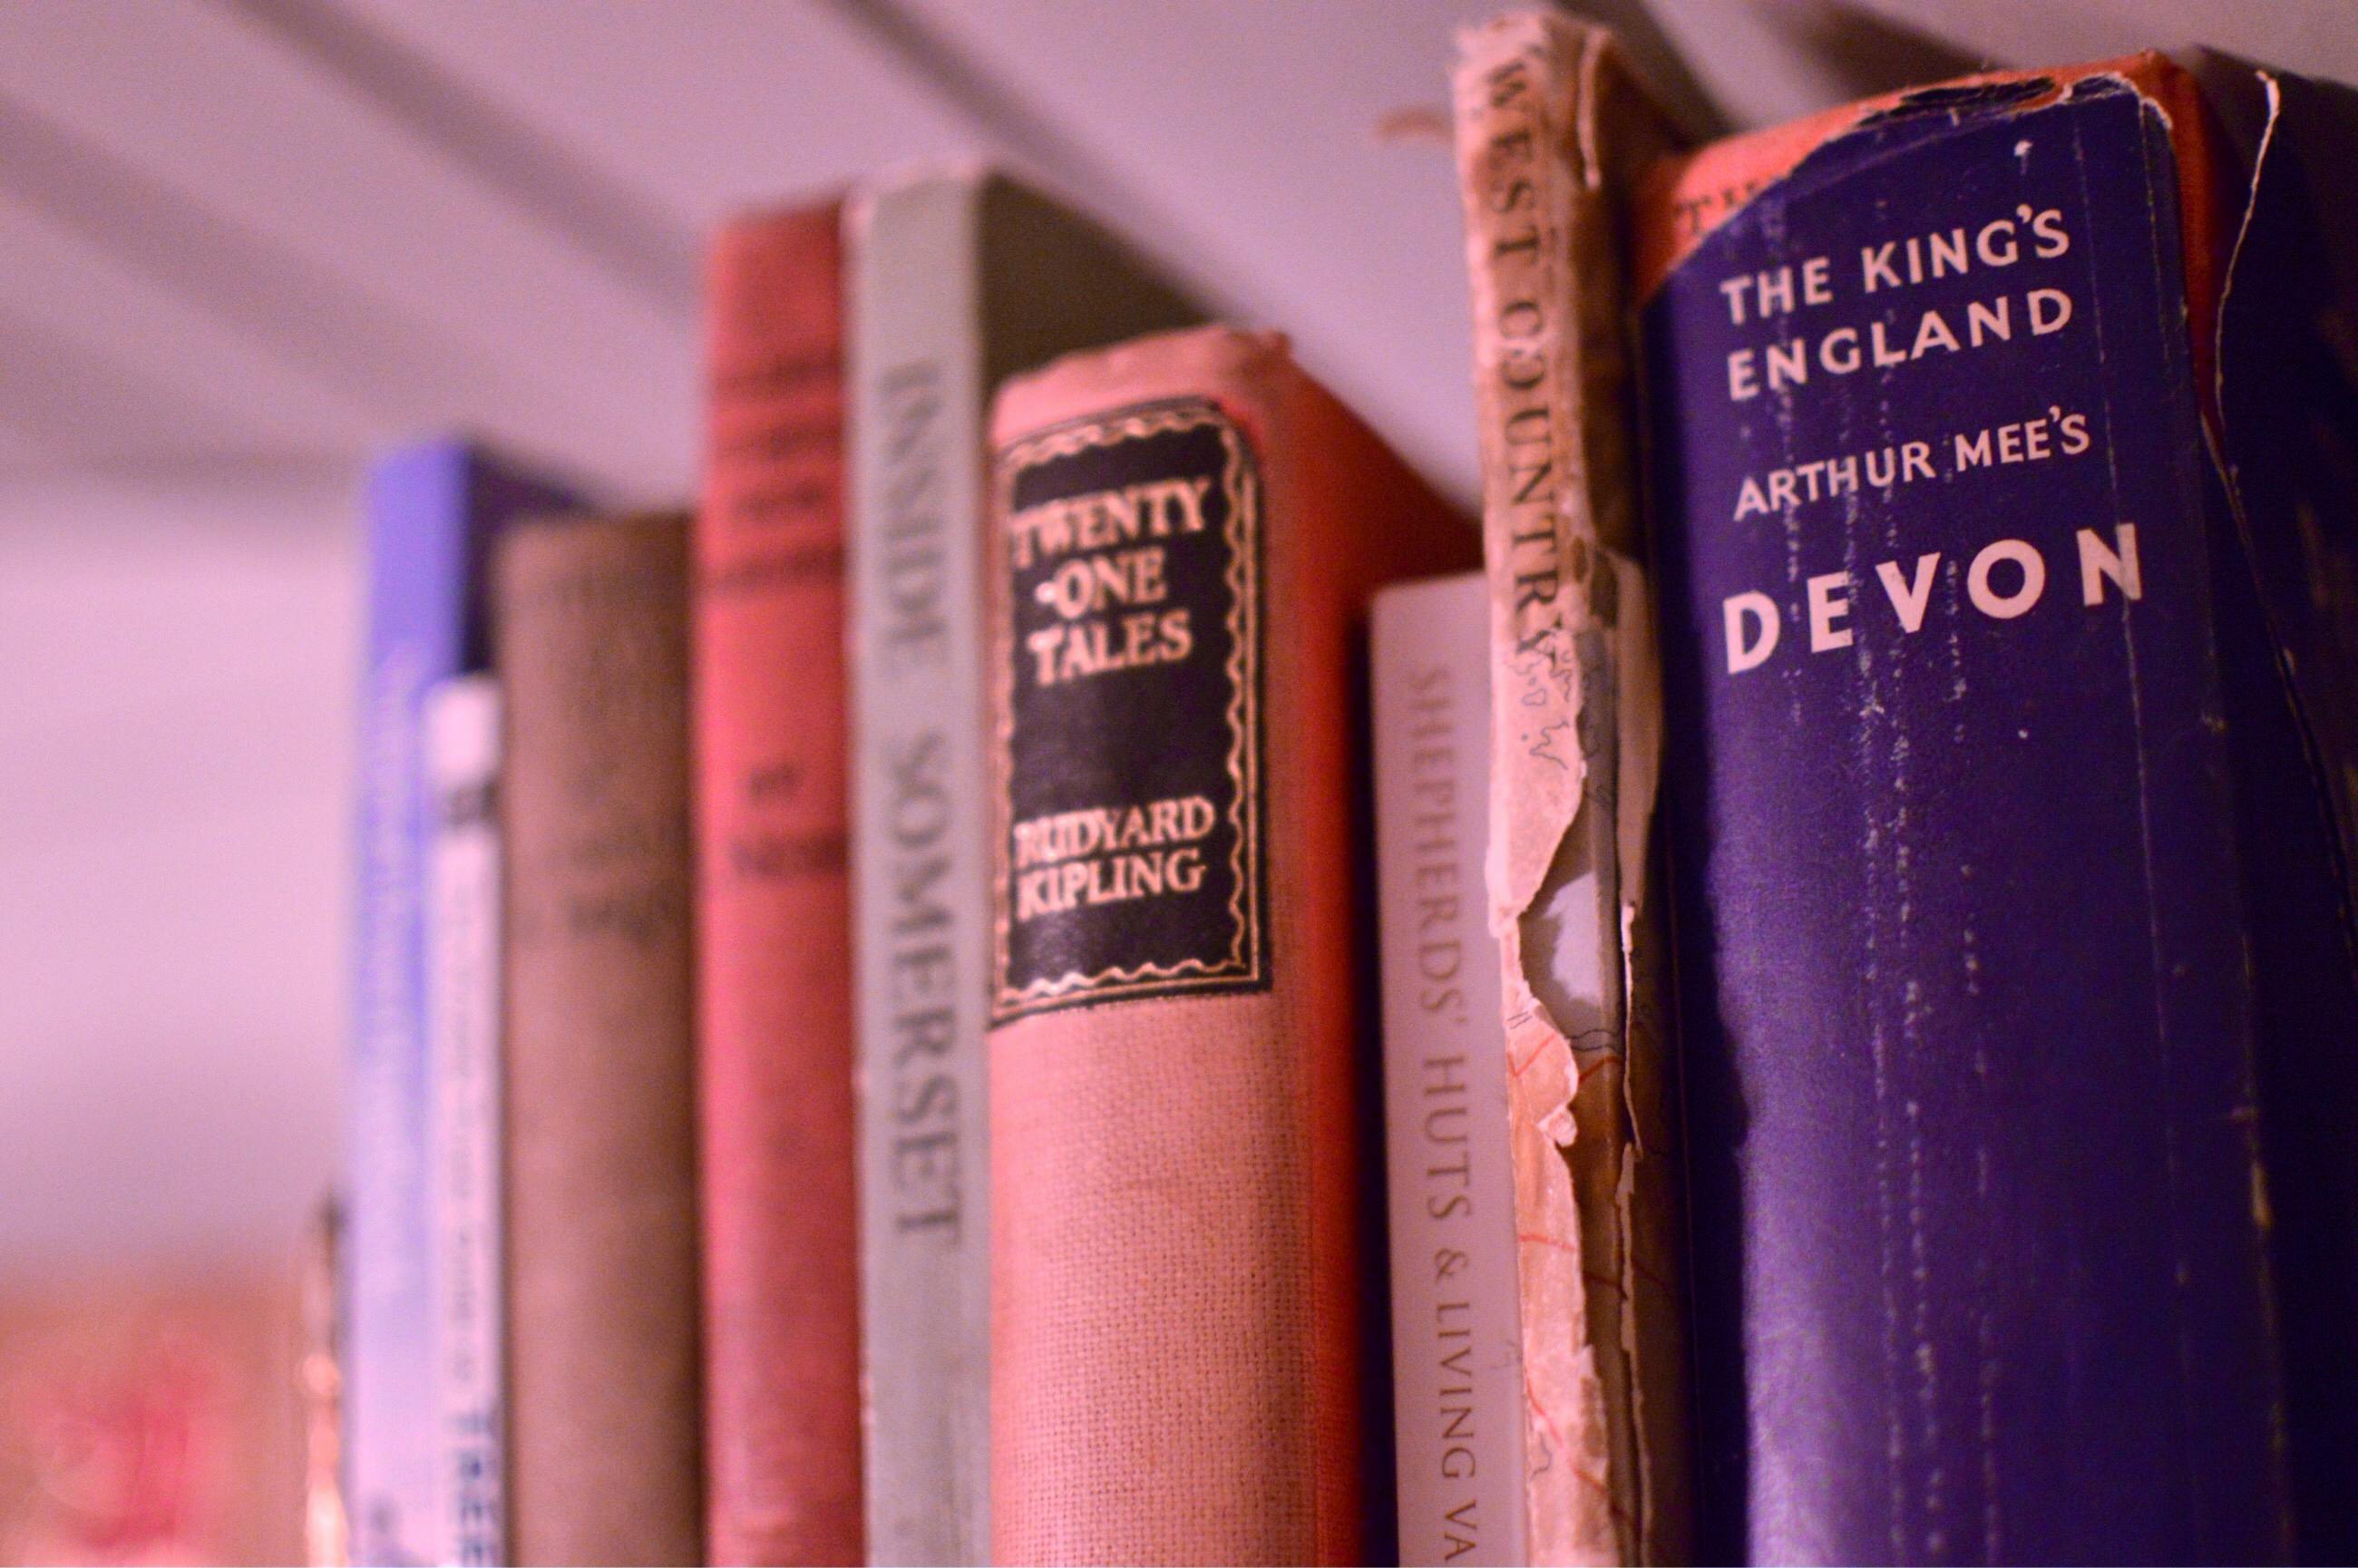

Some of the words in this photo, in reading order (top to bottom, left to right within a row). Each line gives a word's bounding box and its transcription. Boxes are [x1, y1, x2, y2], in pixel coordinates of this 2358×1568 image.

[1720, 257, 1833, 326] THE
[1860, 203, 2070, 294] KING'S
[1727, 287, 2073, 402] ENGLAND
[876, 360, 949, 670] INSIDE
[1499, 298, 1564, 667] COUNTRY
[1733, 441, 1937, 521] ARTHUR
[1954, 405, 2090, 472] MEE'S
[1009, 476, 1213, 570] TWENTY
[1027, 608, 1193, 687] TALES
[1723, 521, 2142, 675] DEVON
[1013, 795, 1215, 871] RUDYARD
[1015, 848, 1207, 923] KIPLING
[1408, 667, 1466, 1025] SHEPHERDS'
[884, 730, 961, 1246] SOMERSET
[1422, 1055, 1470, 1222] HUTS
[1434, 1248, 1470, 1281] &
[1435, 1300, 1476, 1481] LIVING
[1443, 1500, 1477, 1563] VA
